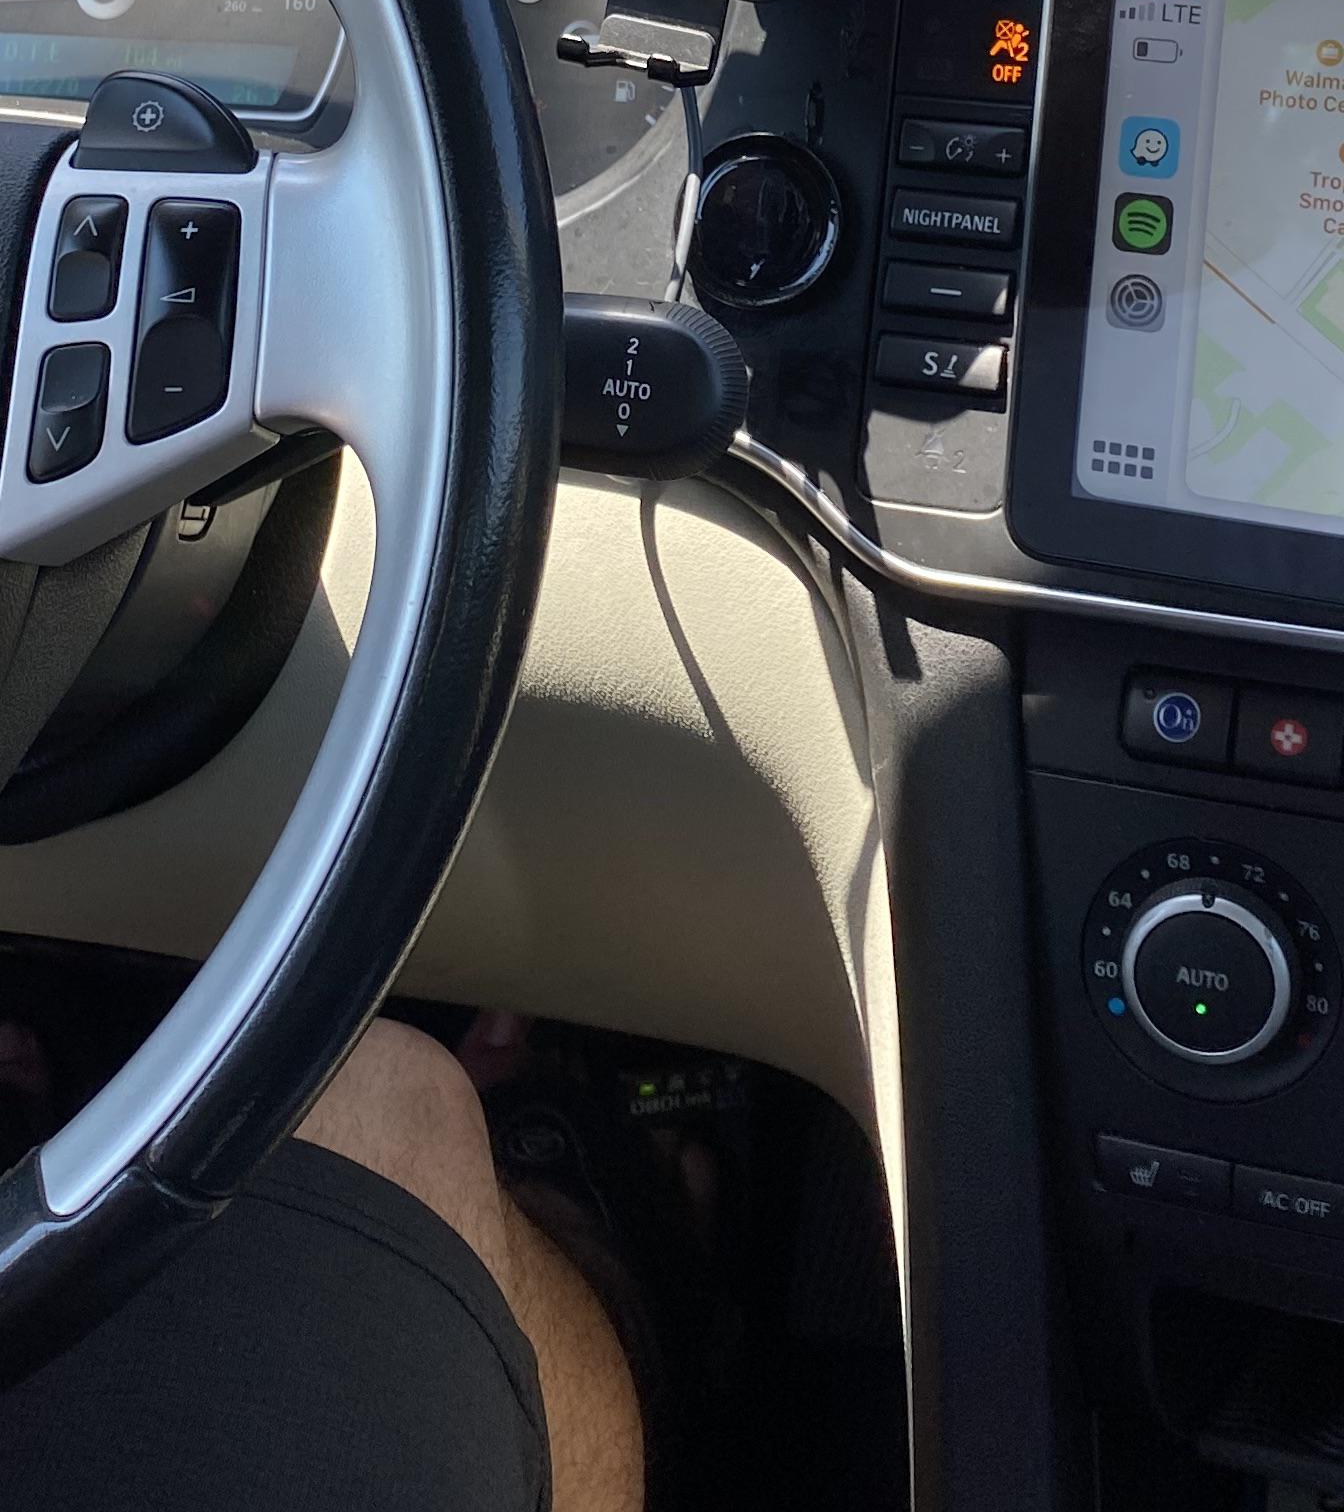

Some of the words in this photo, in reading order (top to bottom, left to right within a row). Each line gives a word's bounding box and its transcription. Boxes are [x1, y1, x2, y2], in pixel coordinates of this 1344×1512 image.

[224, 0, 247, 13] 260
[1161, 3, 1202, 26] LTE
[992, 64, 1023, 83] OFF
[1258, 89, 1319, 114] Photo
[902, 206, 1002, 235] NIGHTPANEL
[627, 337, 640, 356] 2
[625, 359, 633, 376] 1
[602, 381, 652, 401] AUTO
[618, 402, 631, 420] 0
[1167, 853, 1191, 870] 68
[1242, 864, 1265, 883] 72
[1108, 891, 1132, 909] 64
[1298, 920, 1321, 941] 76
[1093, 960, 1118, 978] 60
[1176, 965, 1230, 991] AUTO
[1306, 995, 1329, 1015] 80
[1262, 1190, 1289, 1212] AC
[1294, 1196, 1332, 1219] OFF
